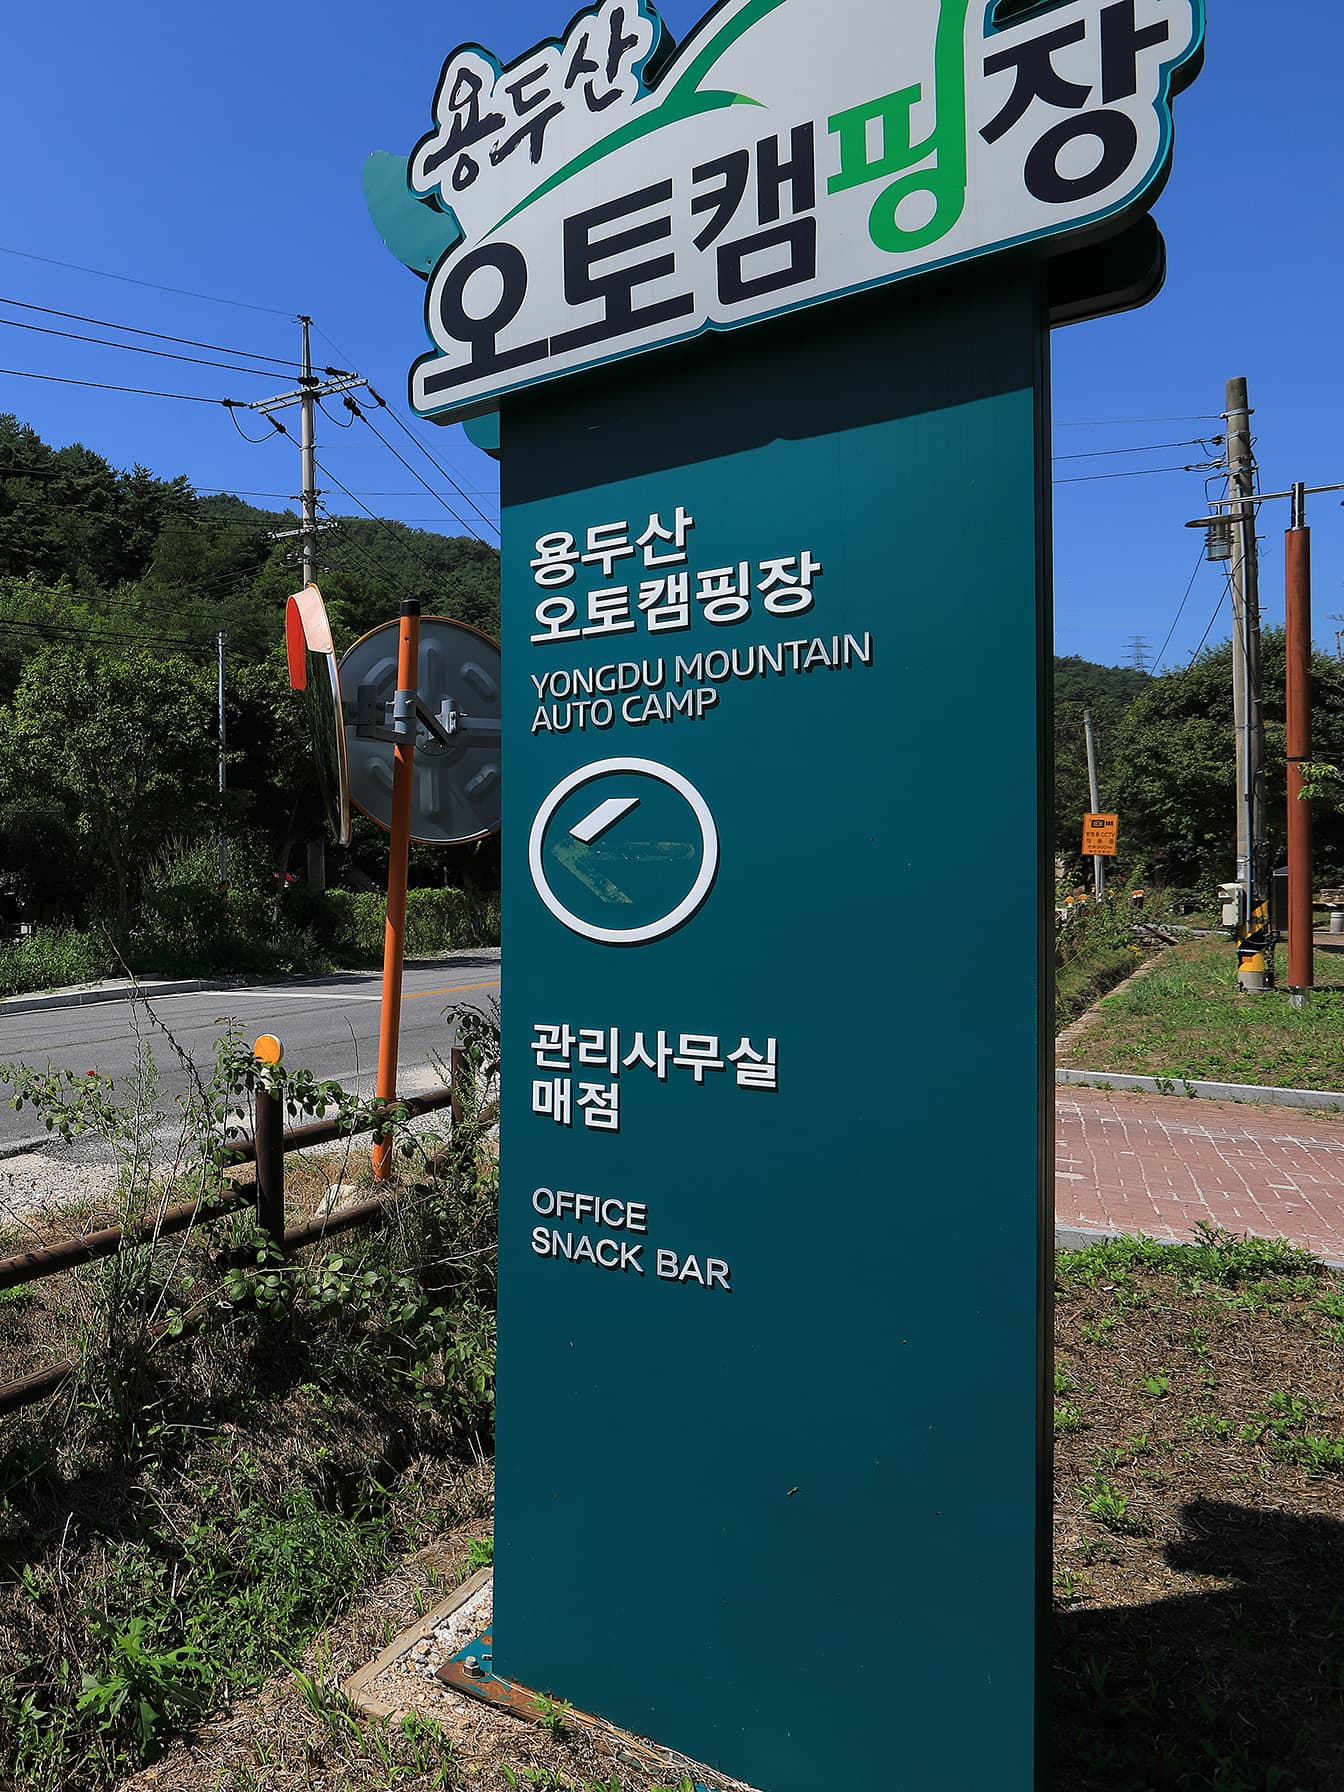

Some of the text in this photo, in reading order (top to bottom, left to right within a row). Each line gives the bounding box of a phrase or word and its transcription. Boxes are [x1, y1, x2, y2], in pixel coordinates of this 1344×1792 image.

[424, 6, 638, 192] 용두산
[424, 0, 1169, 396] 오토캠핑장
[529, 506, 693, 586] 용두산
[529, 551, 821, 643] 오토캠핑장
[530, 631, 872, 700] YONGDU MOUNTAIN
[530, 688, 718, 732] AUTO CAMP
[530, 1023, 778, 1089] 관리사무실
[531, 1077, 620, 1130] 매점
[531, 1186, 648, 1232] OFFICE
[530, 1225, 732, 1290] SNACK BAR
